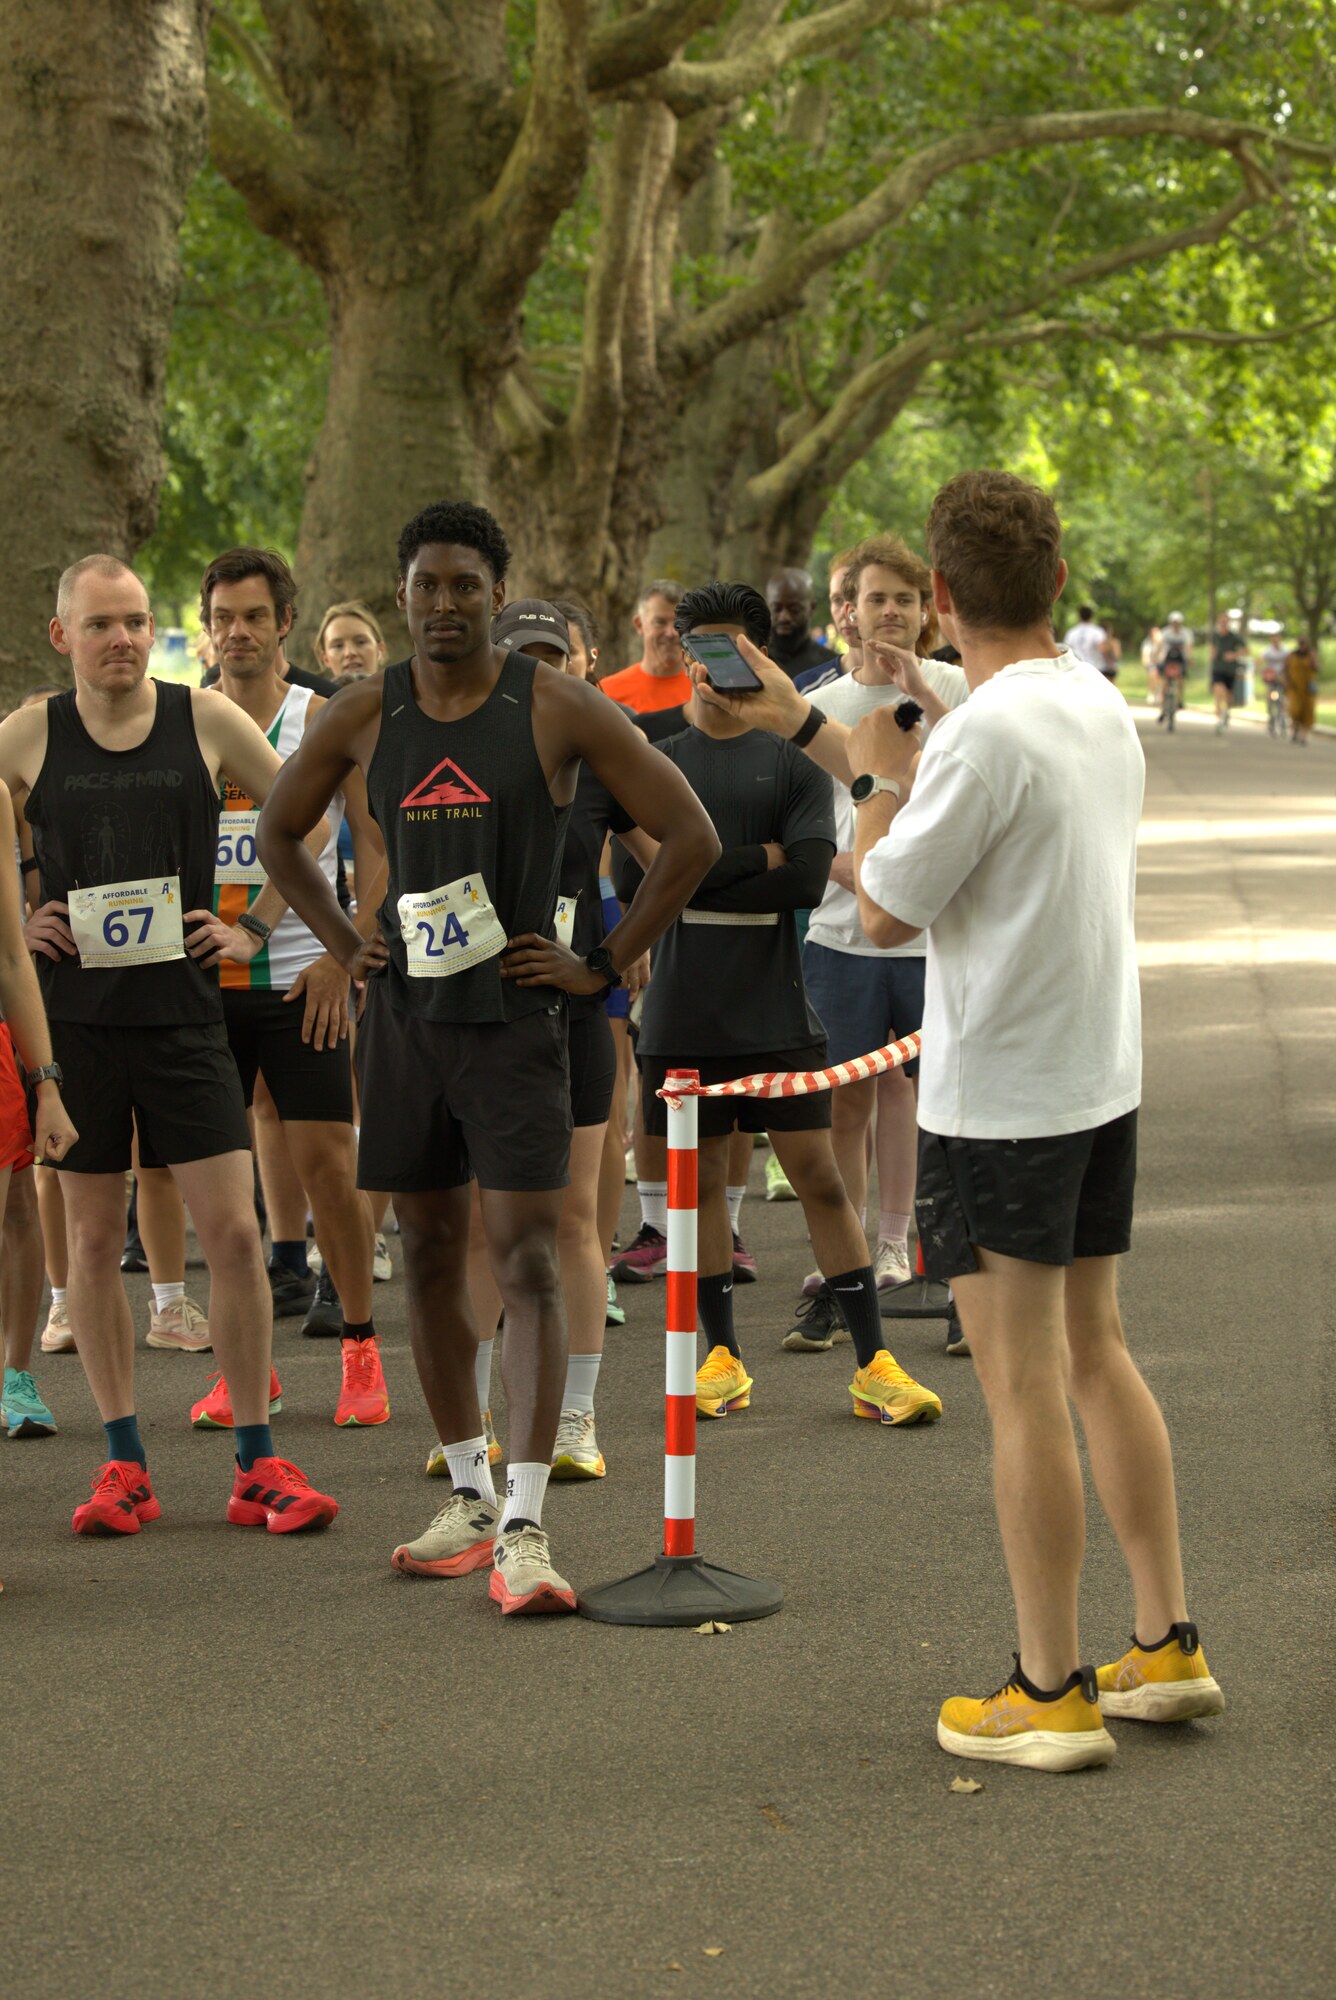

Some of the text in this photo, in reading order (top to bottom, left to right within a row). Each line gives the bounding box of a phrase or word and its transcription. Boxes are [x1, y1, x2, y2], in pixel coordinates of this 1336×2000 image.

[63, 771, 111, 792] PACE
[136, 768, 184, 788] MIND
[407, 808, 483, 822] NIKE TRAIL
[216, 834, 257, 867] 60
[102, 888, 148, 899] AFFORDABLE
[161, 883, 170, 895] A
[463, 881, 472, 895] A
[108, 897, 144, 908] RUNNING
[167, 893, 174, 904] R
[413, 894, 450, 909] AFFORDABLE
[470, 889, 479, 903] R
[416, 903, 447, 918] RUNNING
[102, 907, 154, 948] 67
[416, 911, 470, 957] 24
